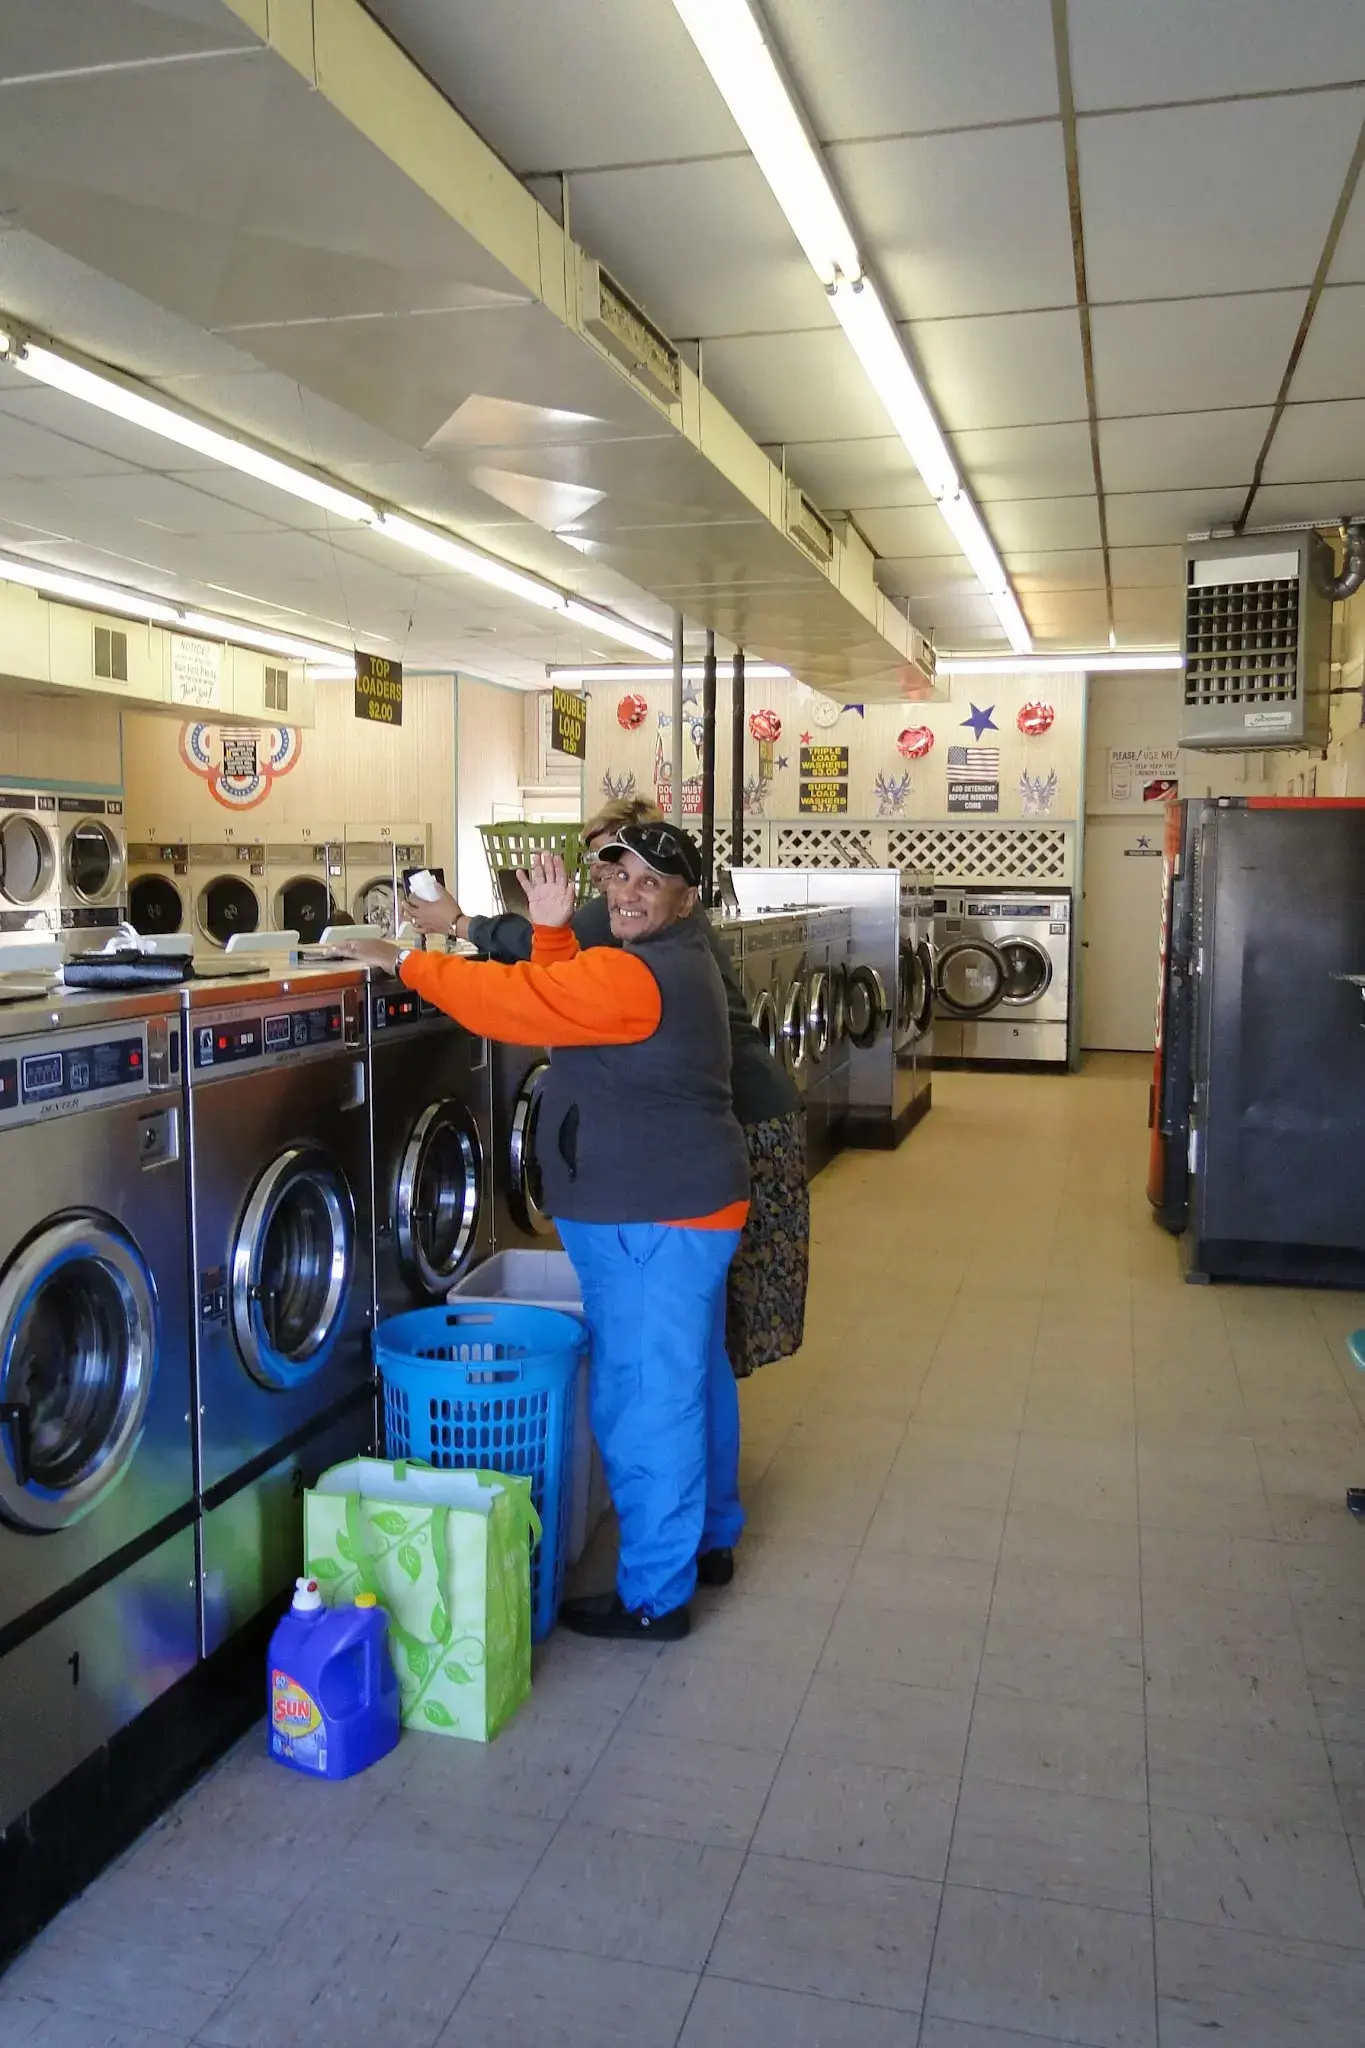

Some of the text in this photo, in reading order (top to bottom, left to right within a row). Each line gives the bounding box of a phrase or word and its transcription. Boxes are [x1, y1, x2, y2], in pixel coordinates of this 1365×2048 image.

[369, 656, 390, 677] TOP
[356, 679, 402, 702] LOADERS
[553, 688, 586, 722] DOUBLE
[368, 699, 393, 722] $2.00
[558, 715, 581, 742] LOAD
[807, 747, 842, 755] TRIPLE
[811, 754, 838, 762] LOAD
[1143, 752, 1159, 760] USE
[801, 761, 848, 769] WASHERS
[811, 768, 839, 776] $3.00
[681, 785, 703, 795] MUST
[807, 783, 840, 791] SUPER
[951, 785, 996, 793] ADD DETERGENT
[810, 790, 837, 798] LOAD
[948, 793, 970, 801] BEFORE
[659, 794, 670, 804] BE
[800, 797, 847, 805] WASHERS
[663, 803, 698, 812] TO ART
[811, 804, 838, 813] $3.75
[964, 802, 982, 810] COINS
[148, 828, 156, 836] 17
[224, 828, 234, 836] 18
[301, 828, 311, 837] 19
[380, 827, 391, 836] 20
[1012, 1028, 1019, 1037] 5
[67, 1650, 80, 1686] 1
[275, 1699, 310, 1721] SUN
